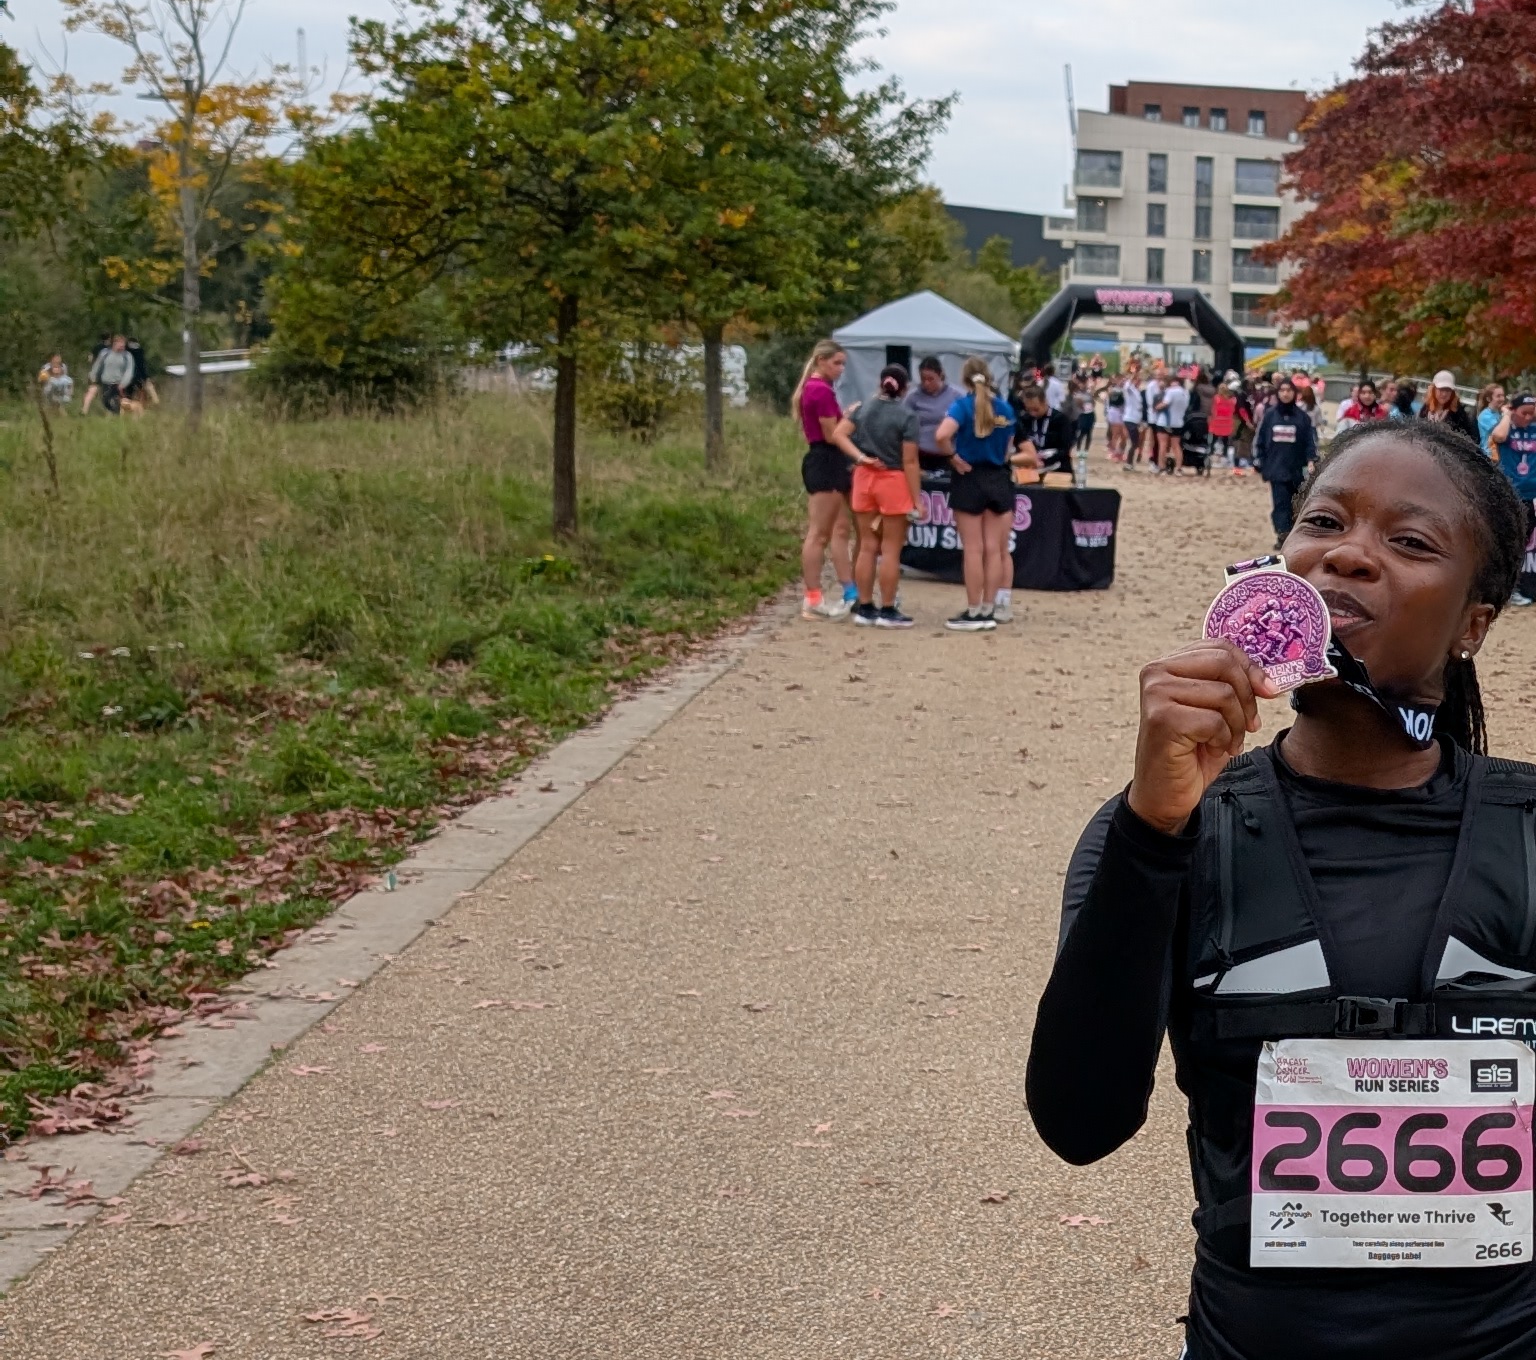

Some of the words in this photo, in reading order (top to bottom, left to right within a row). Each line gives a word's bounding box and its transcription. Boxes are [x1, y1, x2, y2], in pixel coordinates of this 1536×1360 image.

[1095, 289, 1174, 306] WOMEN'S
[904, 526, 938, 549] UN
[1273, 672, 1302, 686] ERIES
[1276, 1057, 1309, 1067] BREAST
[1347, 1057, 1449, 1080] WOMEN'S
[1276, 1067, 1311, 1076] CANCER
[1355, 1079, 1384, 1093] RUN
[1388, 1079, 1440, 1093] SERIES
[1258, 1111, 1522, 1193] 2666
[1269, 1210, 1313, 1219] RunThrough
[1320, 1209, 1394, 1228] Together
[1397, 1212, 1421, 1224] we
[1424, 1209, 1476, 1224] Thrive
[1475, 1241, 1523, 1259] 2666
